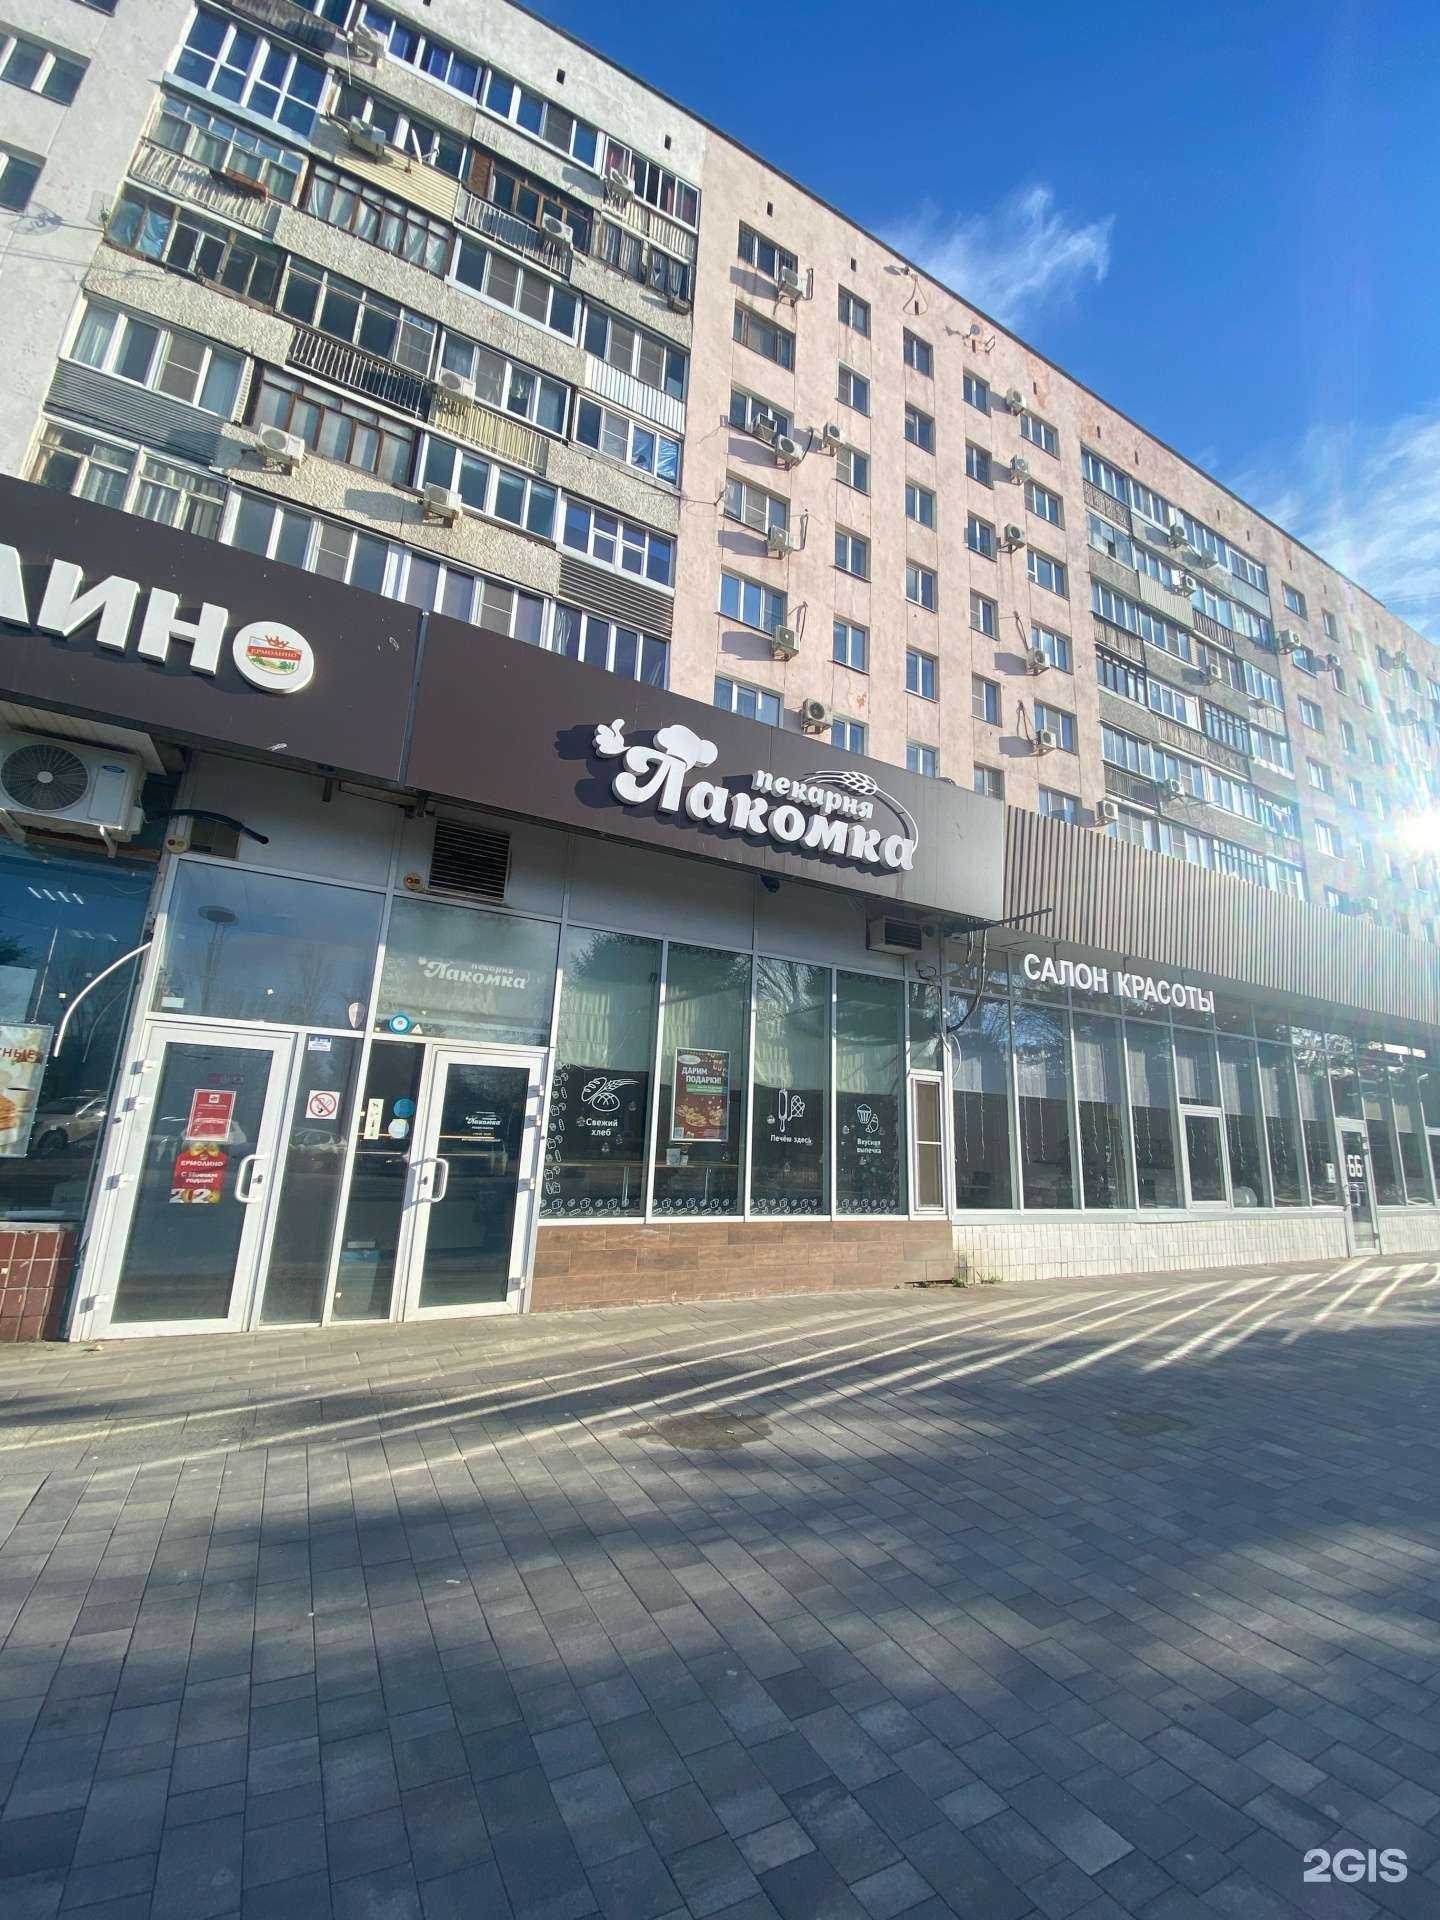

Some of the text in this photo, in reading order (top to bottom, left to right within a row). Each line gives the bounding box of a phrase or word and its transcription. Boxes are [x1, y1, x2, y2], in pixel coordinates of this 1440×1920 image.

[611, 744, 915, 871] Лакомка
[752, 769, 874, 822] пекарня
[423, 960, 526, 989] Лакомка
[1023, 953, 1215, 1014] САЛОН КРАСОТЫ
[681, 1066, 708, 1075] ДАРИМ
[586, 1118, 618, 1127] Свежий
[591, 1128, 611, 1137] хлеб
